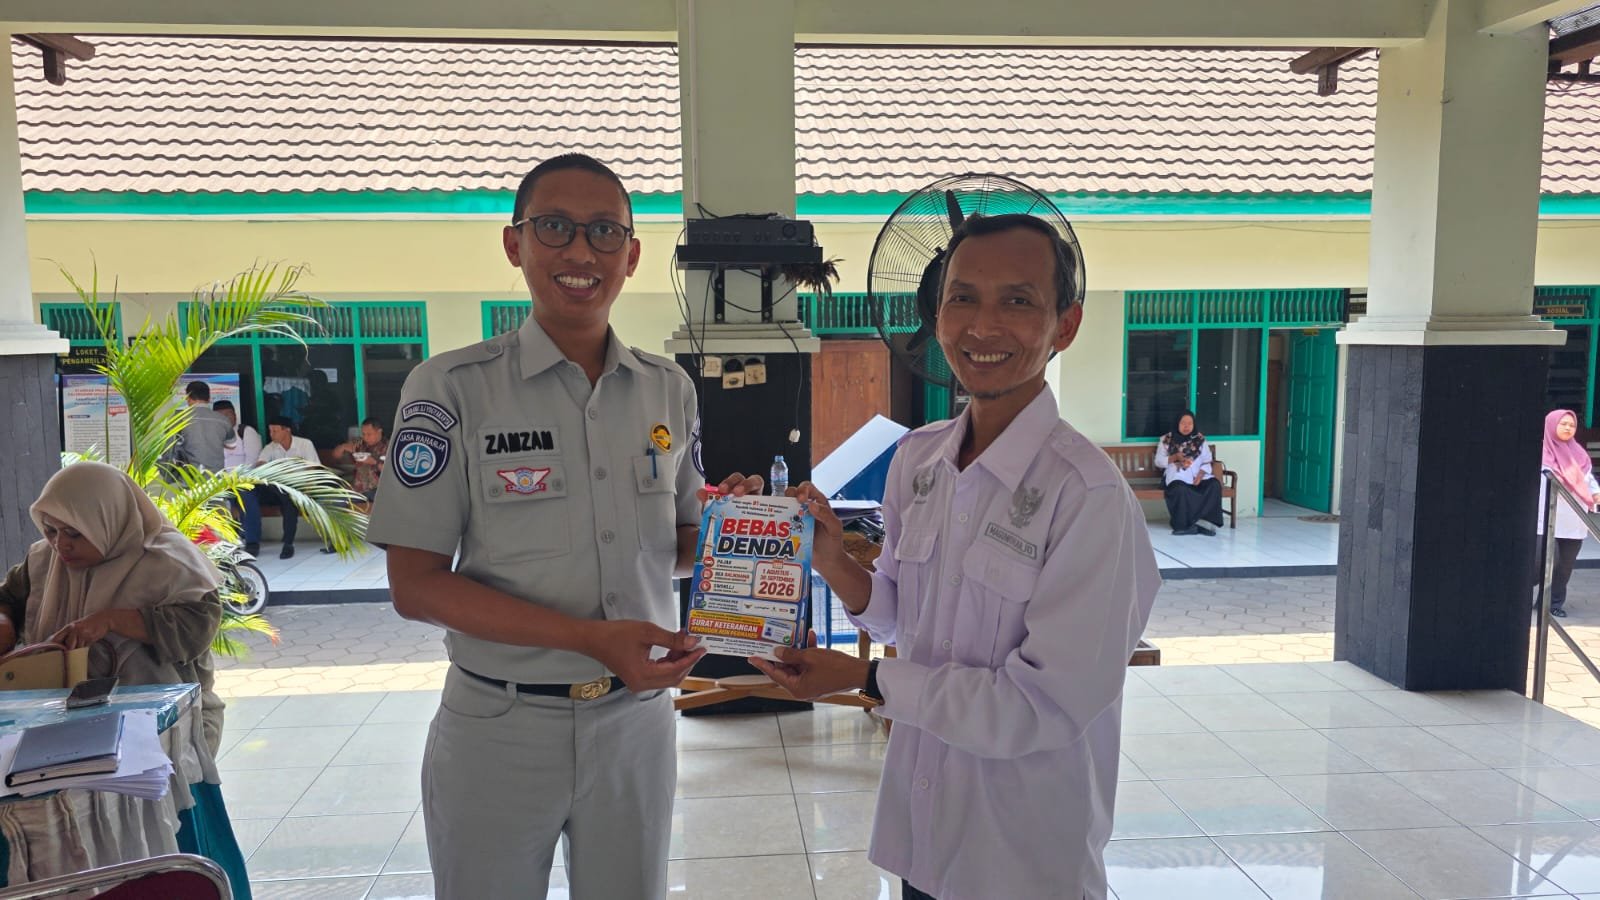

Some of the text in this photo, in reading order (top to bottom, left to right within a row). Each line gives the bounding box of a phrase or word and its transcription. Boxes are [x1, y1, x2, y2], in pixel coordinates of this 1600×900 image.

[400, 434, 445, 452] JASA RAHARJA
[722, 518, 790, 537] BEBAS
[758, 581, 795, 596] 2026
[715, 621, 758, 632] KETERANGAN
